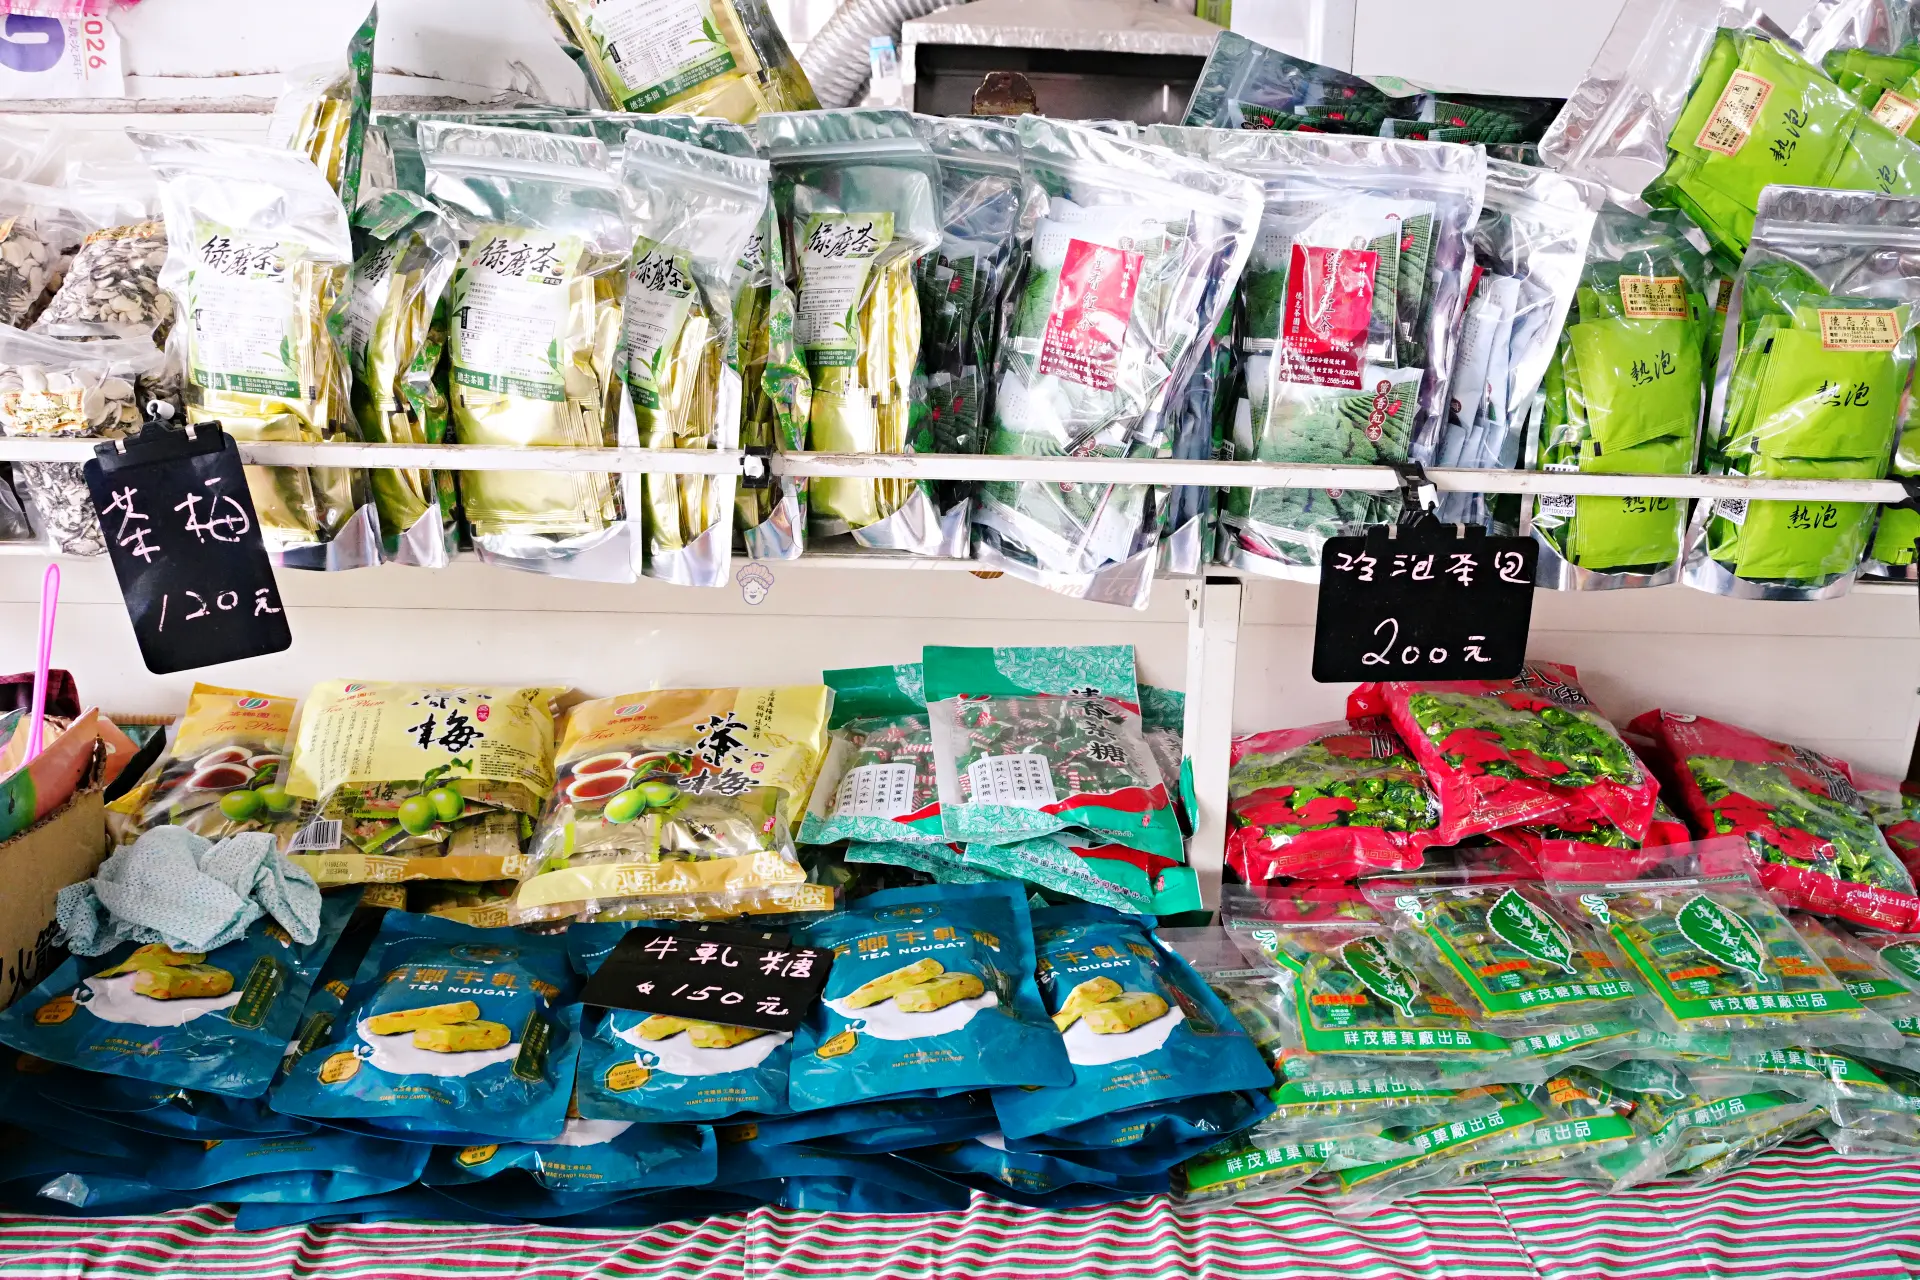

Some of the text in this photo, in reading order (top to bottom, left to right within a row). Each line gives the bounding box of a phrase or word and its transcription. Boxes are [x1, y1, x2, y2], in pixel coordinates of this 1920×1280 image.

[1768, 107, 1808, 167] 熱泡
[201, 235, 280, 277] 綠磨茶
[480, 236, 560, 277] 綠磨茶
[806, 221, 879, 260] 綠磨茶
[1630, 349, 1677, 388] 熱泡
[1367, 382, 1391, 439] 蜜香紅茶
[1813, 381, 1870, 408] 熱泡
[101, 477, 251, 564] 茶梅
[1786, 504, 1838, 530] 熱泡
[1332, 551, 1531, 587] 冷泡茶包
[158, 588, 282, 632] 120元
[1361, 617, 1492, 665] 200元
[643, 935, 818, 978] 牛軋糖
[859, 941, 967, 962] TEA NOUGAT
[408, 983, 518, 998] TEA NOUGAT
[1037, 959, 1132, 986] EA NOUGAT
[1518, 980, 1636, 1005] 祥茂糖菓廠出品
[1707, 992, 1828, 1012] 祥茂糖菓廠出品
[1343, 1030, 1472, 1047] 祥茂糖菓廠出品
